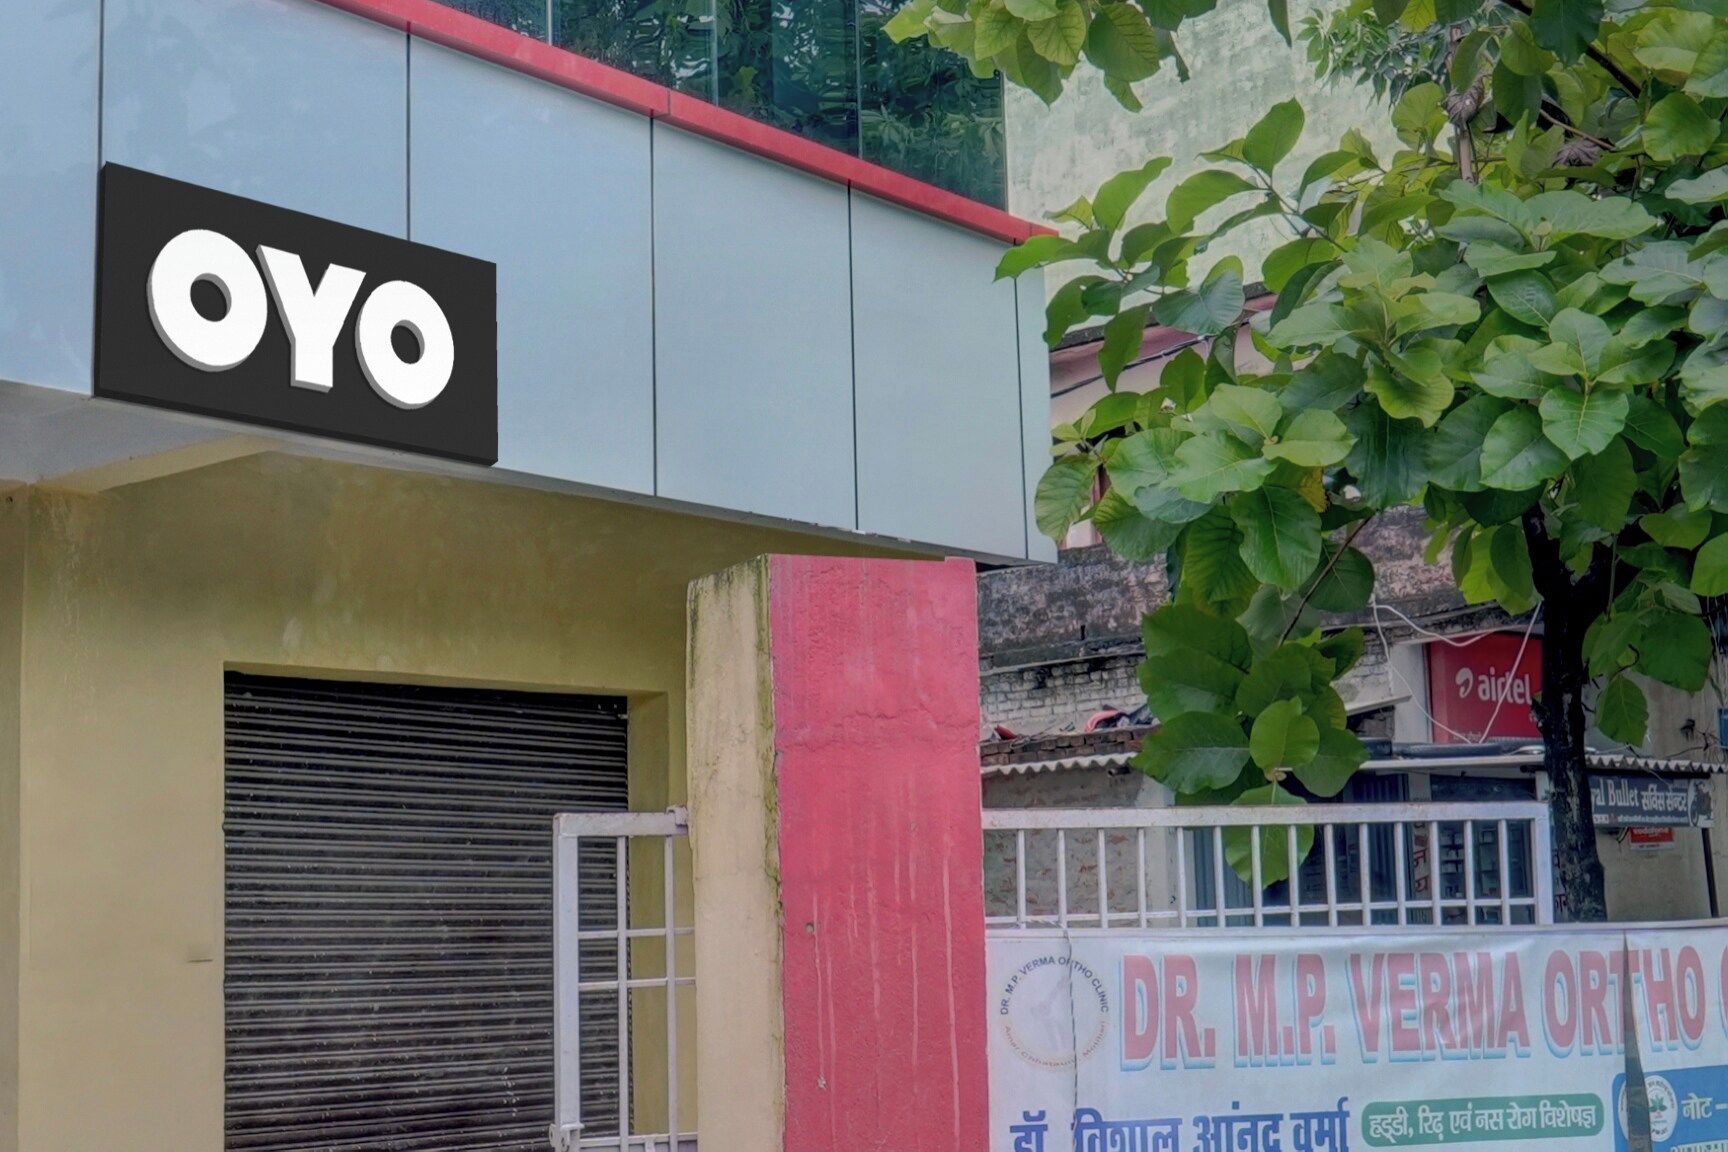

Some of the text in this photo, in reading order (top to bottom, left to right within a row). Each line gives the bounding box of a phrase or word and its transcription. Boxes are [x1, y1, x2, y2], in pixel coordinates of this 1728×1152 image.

[147, 228, 454, 410] OYO
[1477, 666, 1532, 705] airtel
[1607, 778, 1639, 806] Bullet
[1640, 784, 1665, 811] सर्विस
[1000, 997, 1011, 1015] DR.
[1019, 956, 1055, 975] VERMA
[1058, 956, 1093, 979] ORTHO
[1092, 978, 1109, 1013] CLINIC
[1120, 954, 1216, 1071] DR.
[1231, 953, 1337, 1067] M.P.
[1345, 950, 1531, 1063] VERMA
[1541, 945, 1706, 1059] ORTHO
[1071, 1107, 1182, 1152] विशाल
[1192, 1101, 1284, 1152] आनंद
[1290, 1096, 1350, 1152] वर्मा
[1448, 1101, 1473, 1134] एवं
[1474, 1109, 1504, 1131] नस
[1506, 1102, 1537, 1130] रोग
[1681, 1092, 1713, 1120] नोट
